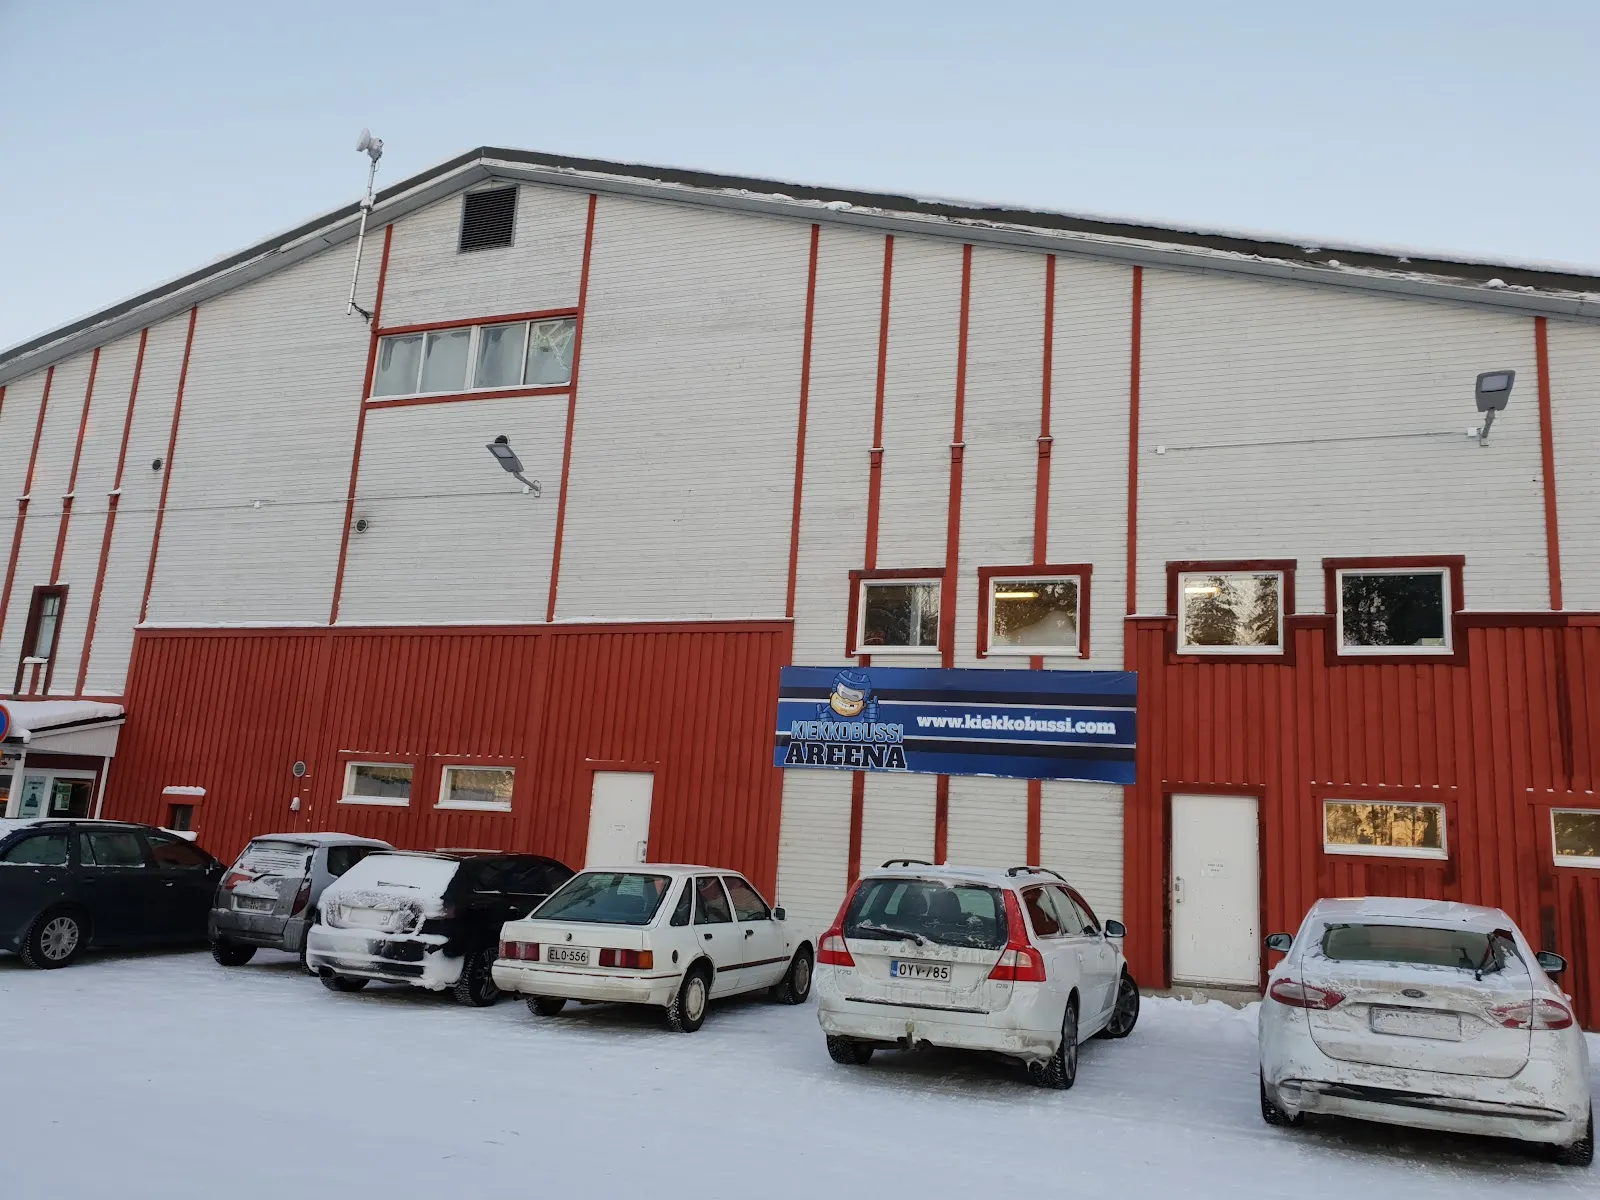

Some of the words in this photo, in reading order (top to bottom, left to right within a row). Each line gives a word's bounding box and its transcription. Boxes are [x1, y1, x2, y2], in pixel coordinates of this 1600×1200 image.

[791, 720, 904, 744] KIEKKOBUSSI
[917, 714, 1116, 735] www.kiekkobussi.com
[784, 742, 908, 770] AREENA
[549, 949, 586, 962] ELO-556
[899, 963, 949, 980] OYV-785
